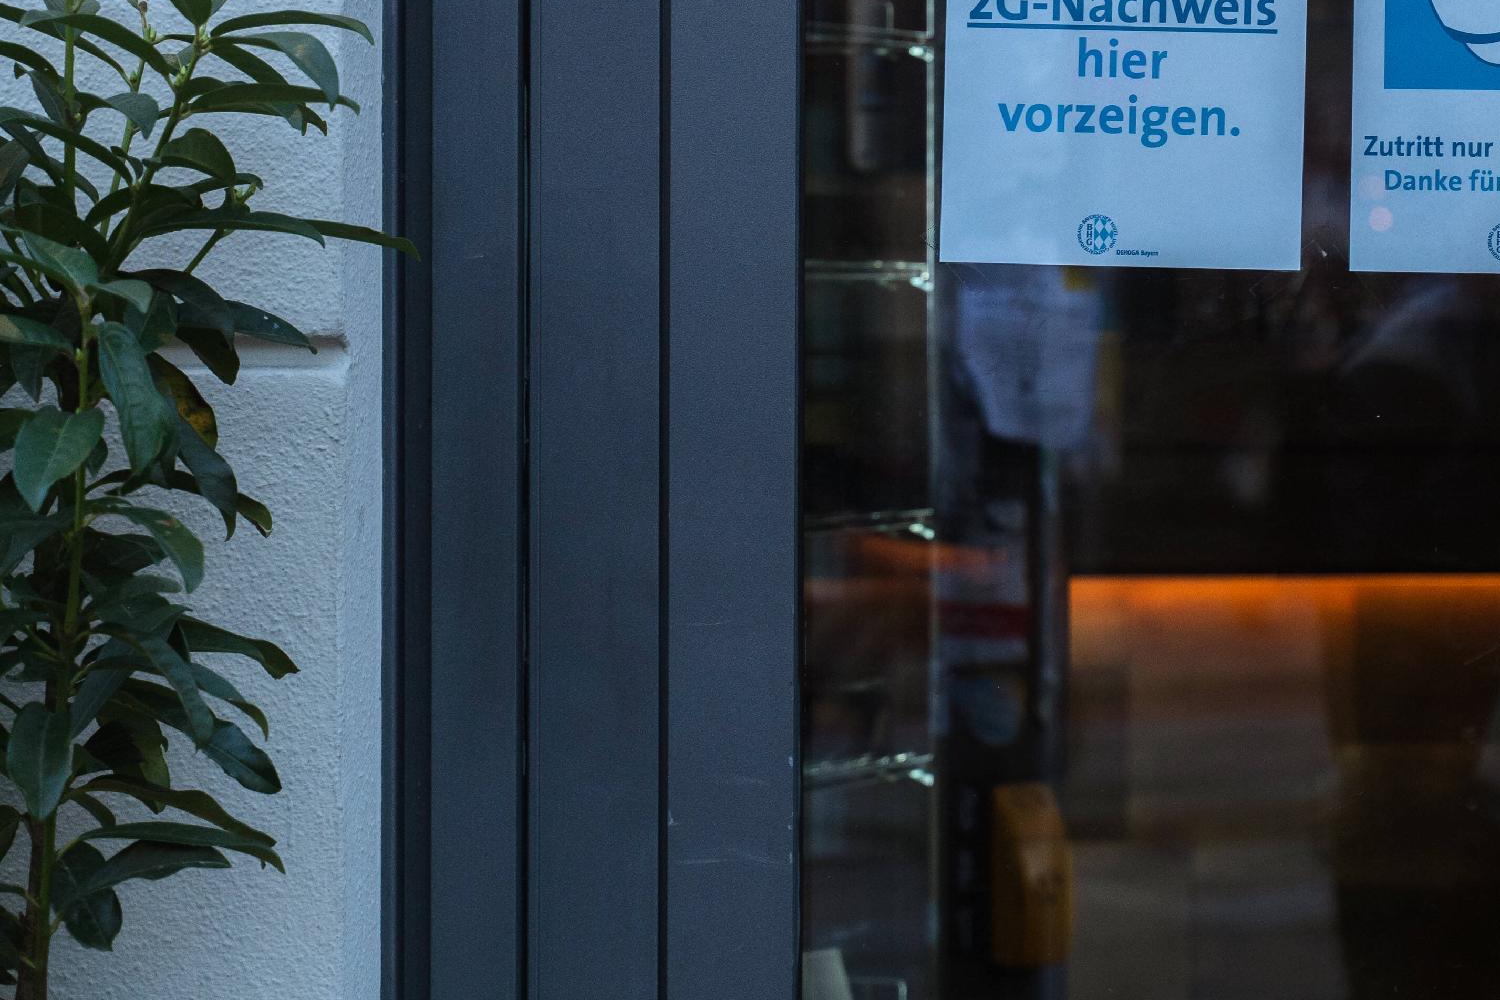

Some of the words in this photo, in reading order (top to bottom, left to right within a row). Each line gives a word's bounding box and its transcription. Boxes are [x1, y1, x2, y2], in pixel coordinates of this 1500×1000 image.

[1078, 37, 1167, 79] hier
[998, 94, 1240, 148] vorzeigen.
[1364, 136, 1444, 157] Zutritt
[1452, 142, 1493, 157] nur
[1385, 169, 1462, 191] Danke
